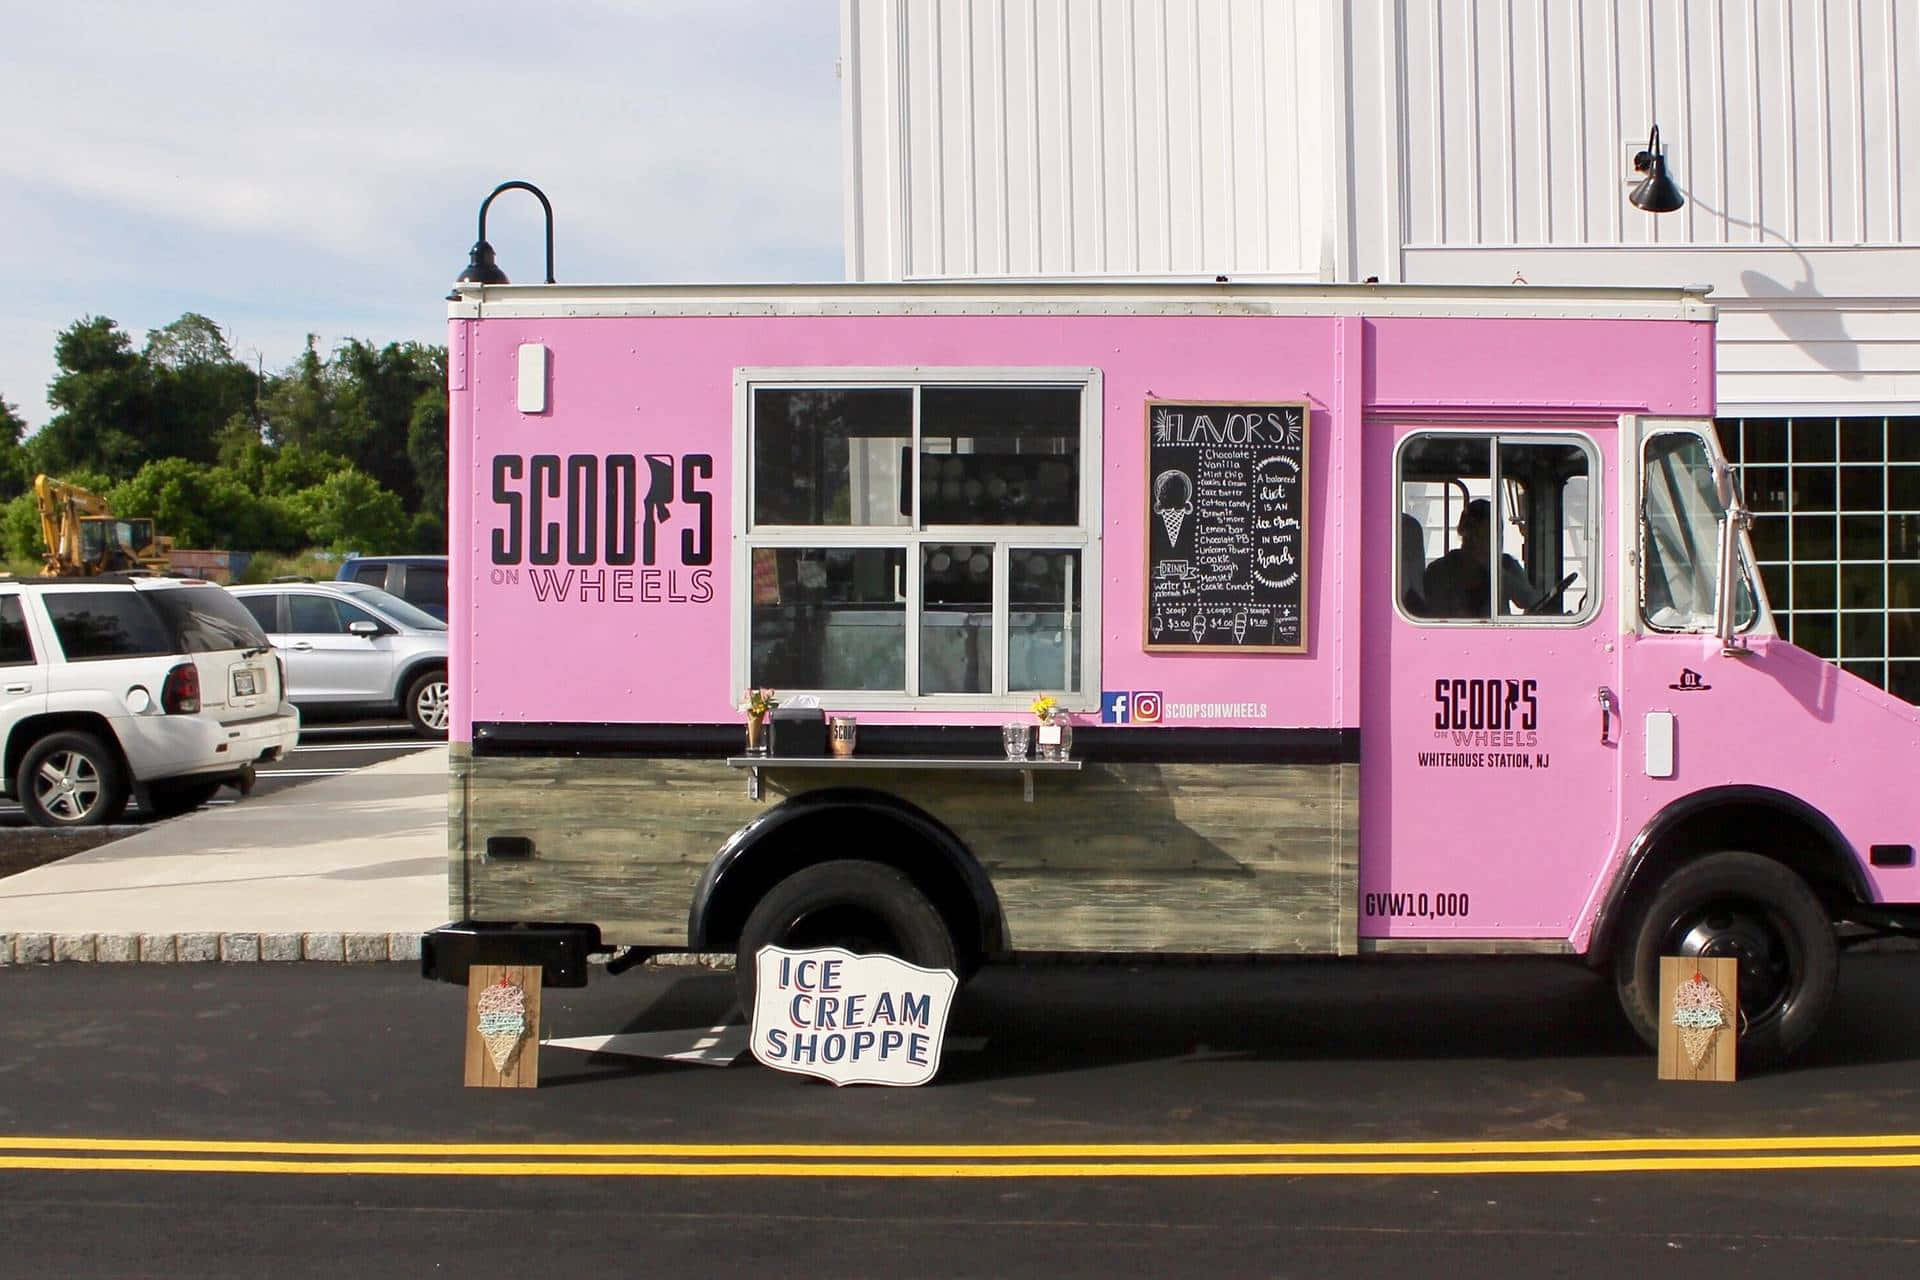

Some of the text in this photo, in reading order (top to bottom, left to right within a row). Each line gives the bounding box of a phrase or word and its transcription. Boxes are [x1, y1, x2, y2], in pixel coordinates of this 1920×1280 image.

[1166, 413, 1284, 443] FLAVORS
[1205, 449, 1250, 459] Chocolate
[1204, 460, 1240, 469] Vanilla
[1204, 470, 1244, 480] Mint Chip
[1257, 473, 1296, 484] A balanced
[1260, 484, 1286, 501] diet
[492, 454, 713, 565] SCOOPS
[1201, 499, 1250, 511] Cotton Candy
[1263, 503, 1288, 512] IS AN
[1200, 524, 1226, 534] Lemon
[1256, 515, 1300, 530] ice cream
[1200, 534, 1250, 544] Chocolate PB
[1261, 534, 1291, 544] IN BOTH
[1199, 544, 1250, 555] Unicorn Power
[1200, 554, 1230, 565] Cookie
[1257, 546, 1295, 568] hands
[1211, 562, 1239, 576] Dough
[490, 569, 714, 603] ON WHEELS
[1225, 582, 1252, 591] Crunch
[1165, 607, 1187, 616] scoop
[1206, 607, 1232, 616] scoops
[1685, 673, 1697, 685] 01
[1165, 703, 1267, 719] SCOOPSONWHEELS
[1435, 679, 1537, 730] SCOOPS
[1452, 731, 1537, 747] WHEELS
[1418, 752, 1550, 770] WHITEHOUSE STATION, NJ
[1366, 893, 1469, 920] GVW10,000
[779, 957, 843, 993] ICE
[789, 992, 930, 1030] CREAM
[766, 1028, 930, 1067] SHOPPE
